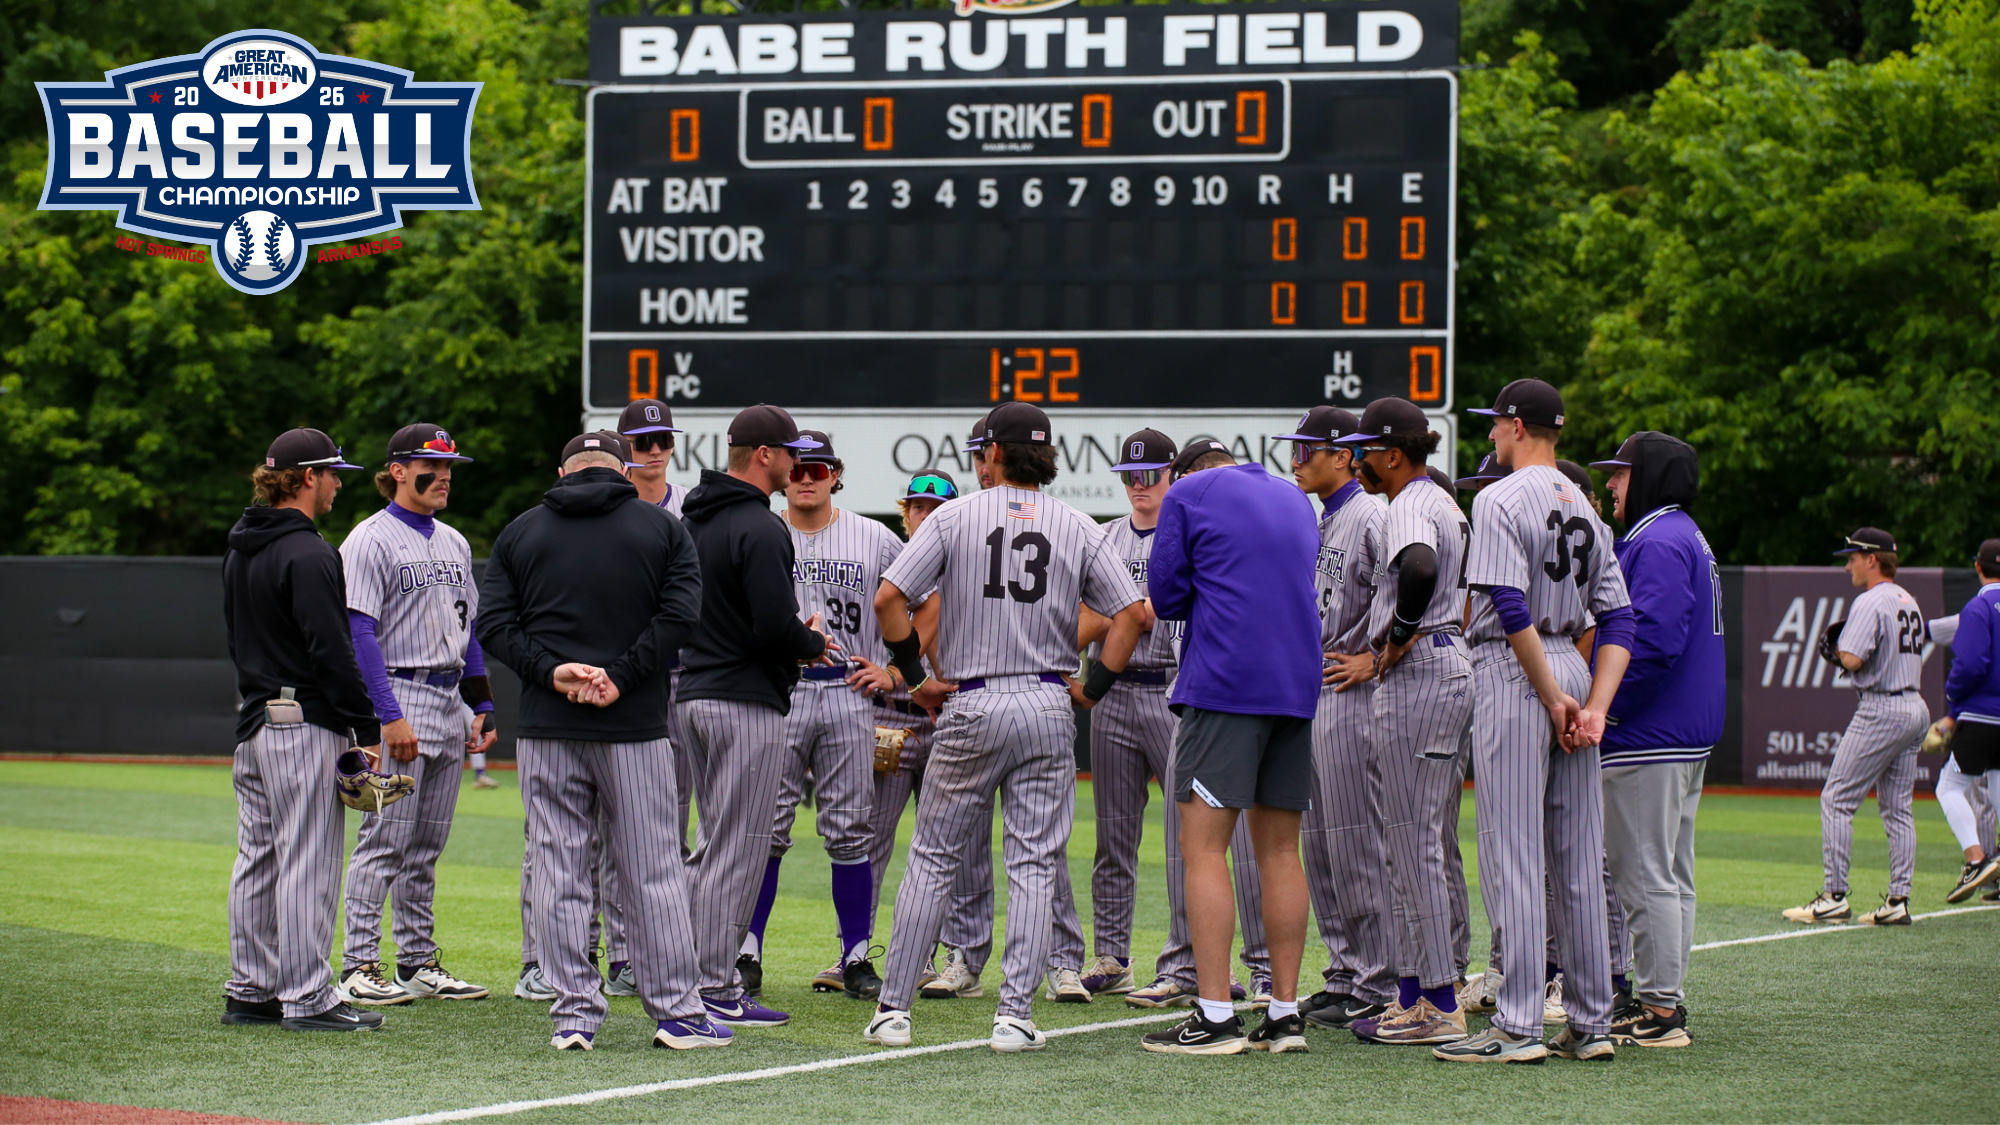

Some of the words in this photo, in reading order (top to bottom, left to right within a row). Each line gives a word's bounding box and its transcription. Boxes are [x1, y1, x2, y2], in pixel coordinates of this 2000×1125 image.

[620, 23, 855, 76] BABE
[886, 17, 1127, 73] RUTH
[1163, 10, 1424, 66] FIELD
[670, 109, 700, 162] 0
[764, 106, 855, 144] BALL
[863, 97, 894, 151] 0
[946, 102, 1074, 141] STRIKE
[1081, 93, 1112, 148] 0
[1152, 100, 1227, 138] OUT
[1235, 90, 1267, 145] 0
[607, 177, 651, 214] AT
[663, 176, 727, 213] BAT
[806, 181, 823, 210] 1
[848, 180, 869, 210] 2
[891, 179, 911, 209] 3
[935, 178, 956, 209] 4
[978, 178, 999, 209] 5
[1021, 177, 1043, 208] 6
[1067, 177, 1088, 207] 7
[1109, 176, 1131, 207] 8
[1154, 175, 1176, 206] 9
[1191, 174, 1228, 206] 10
[1258, 173, 1282, 205] R
[1328, 173, 1353, 204] H
[1401, 172, 1424, 203] E
[619, 225, 765, 263] VISITOR
[1271, 217, 1297, 261] 0
[1342, 216, 1368, 260] 0
[1400, 216, 1425, 260] 0
[640, 287, 749, 324] HOME
[1271, 281, 1296, 325] 0
[1341, 281, 1367, 325] 0
[1399, 280, 1424, 325] 0
[628, 348, 659, 400] 0
[673, 351, 693, 375] V
[990, 347, 1080, 402] 1:22
[1332, 350, 1353, 375] H
[1409, 345, 1441, 401] 0
[665, 374, 701, 399] PC
[1324, 374, 1362, 399] PC
[983, 526, 1053, 604] 13
[1543, 509, 1596, 589] 33
[793, 558, 867, 596] ACHITA
[826, 597, 862, 635] 39
[1897, 609, 1922, 656] 22
